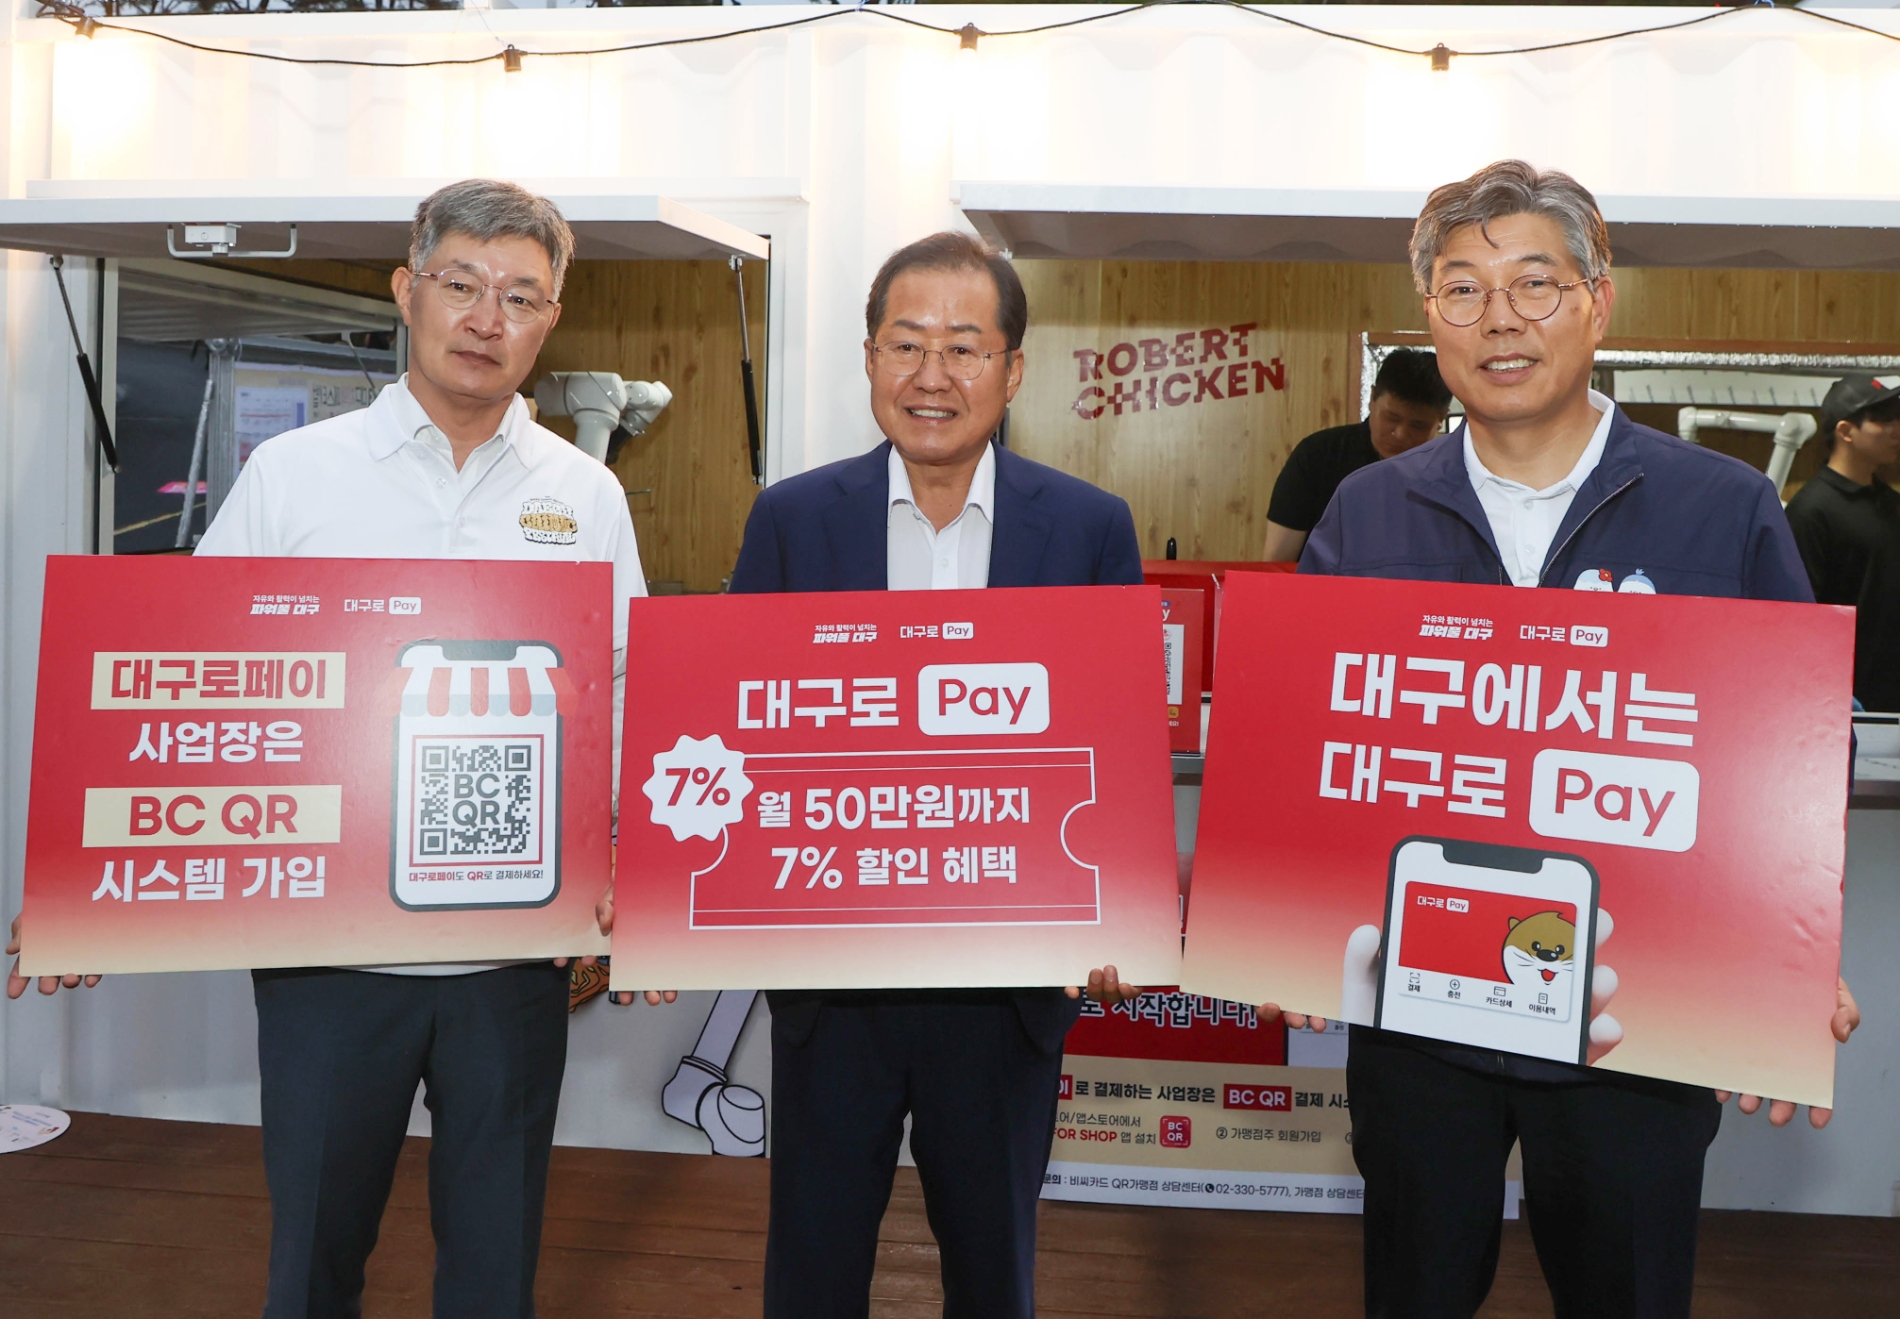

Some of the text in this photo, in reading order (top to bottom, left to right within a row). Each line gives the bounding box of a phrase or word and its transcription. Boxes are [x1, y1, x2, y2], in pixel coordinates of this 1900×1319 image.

[1073, 322, 1257, 383] ROBERT
[1071, 357, 1285, 420] CHICKEN
[298, 595, 320, 603] 넘치는
[344, 599, 417, 612] 대구로 Pay
[250, 604, 320, 615] 파워풀 대구
[857, 623, 877, 631] 넘치는
[1423, 615, 1445, 624] 자유와
[1471, 618, 1493, 627] 넘치는
[812, 631, 877, 644] 파워풀 대구
[900, 625, 969, 639] 대구로 Pay
[1419, 624, 1493, 641] 파워풀 대구
[1519, 625, 1603, 644] 대구로 Pay
[111, 659, 326, 701] 대구로페이
[737, 677, 1031, 729] 대구로 Pay
[1330, 651, 1699, 747] 대구에서는
[129, 721, 304, 763] 사업장은
[453, 773, 500, 799] BC
[665, 767, 731, 807] 7%
[1319, 740, 1676, 837] 대구로 Pay
[452, 800, 500, 829] QR
[757, 784, 1031, 830] 월 50만원까지
[129, 794, 298, 840] BC QR
[409, 869, 544, 882] 대구로페이도 QR로 결제하세요!
[771, 846, 1018, 890] 7% 할인 혜택
[92, 856, 326, 902] 시스템 가입
[1417, 895, 1467, 910] 대구로 Pay
[1407, 983, 1421, 993] 결제
[1528, 1003, 1556, 1015] 이용내역
[1075, 1080, 1089, 1096] 로
[1094, 1081, 1152, 1100] 결제하는
[1157, 1085, 1215, 1103] 사업장은
[1229, 1089, 1255, 1104] BC
[1259, 1090, 1286, 1107] QR
[1295, 1091, 1323, 1108] 결제
[1168, 1122, 1183, 1131] BC
[1231, 1127, 1274, 1141] 가맹점주
[1277, 1129, 1322, 1143] 회원가입
[1080, 1129, 1117, 1142] SHOP
[1121, 1132, 1131, 1144] 앱
[1135, 1132, 1157, 1145] 설치
[1167, 1132, 1183, 1142] QR
[1069, 1175, 1109, 1188] 비씨카드
[1111, 1178, 1158, 1191] QR가맹점
[1295, 1186, 1323, 1198] 가맹점
